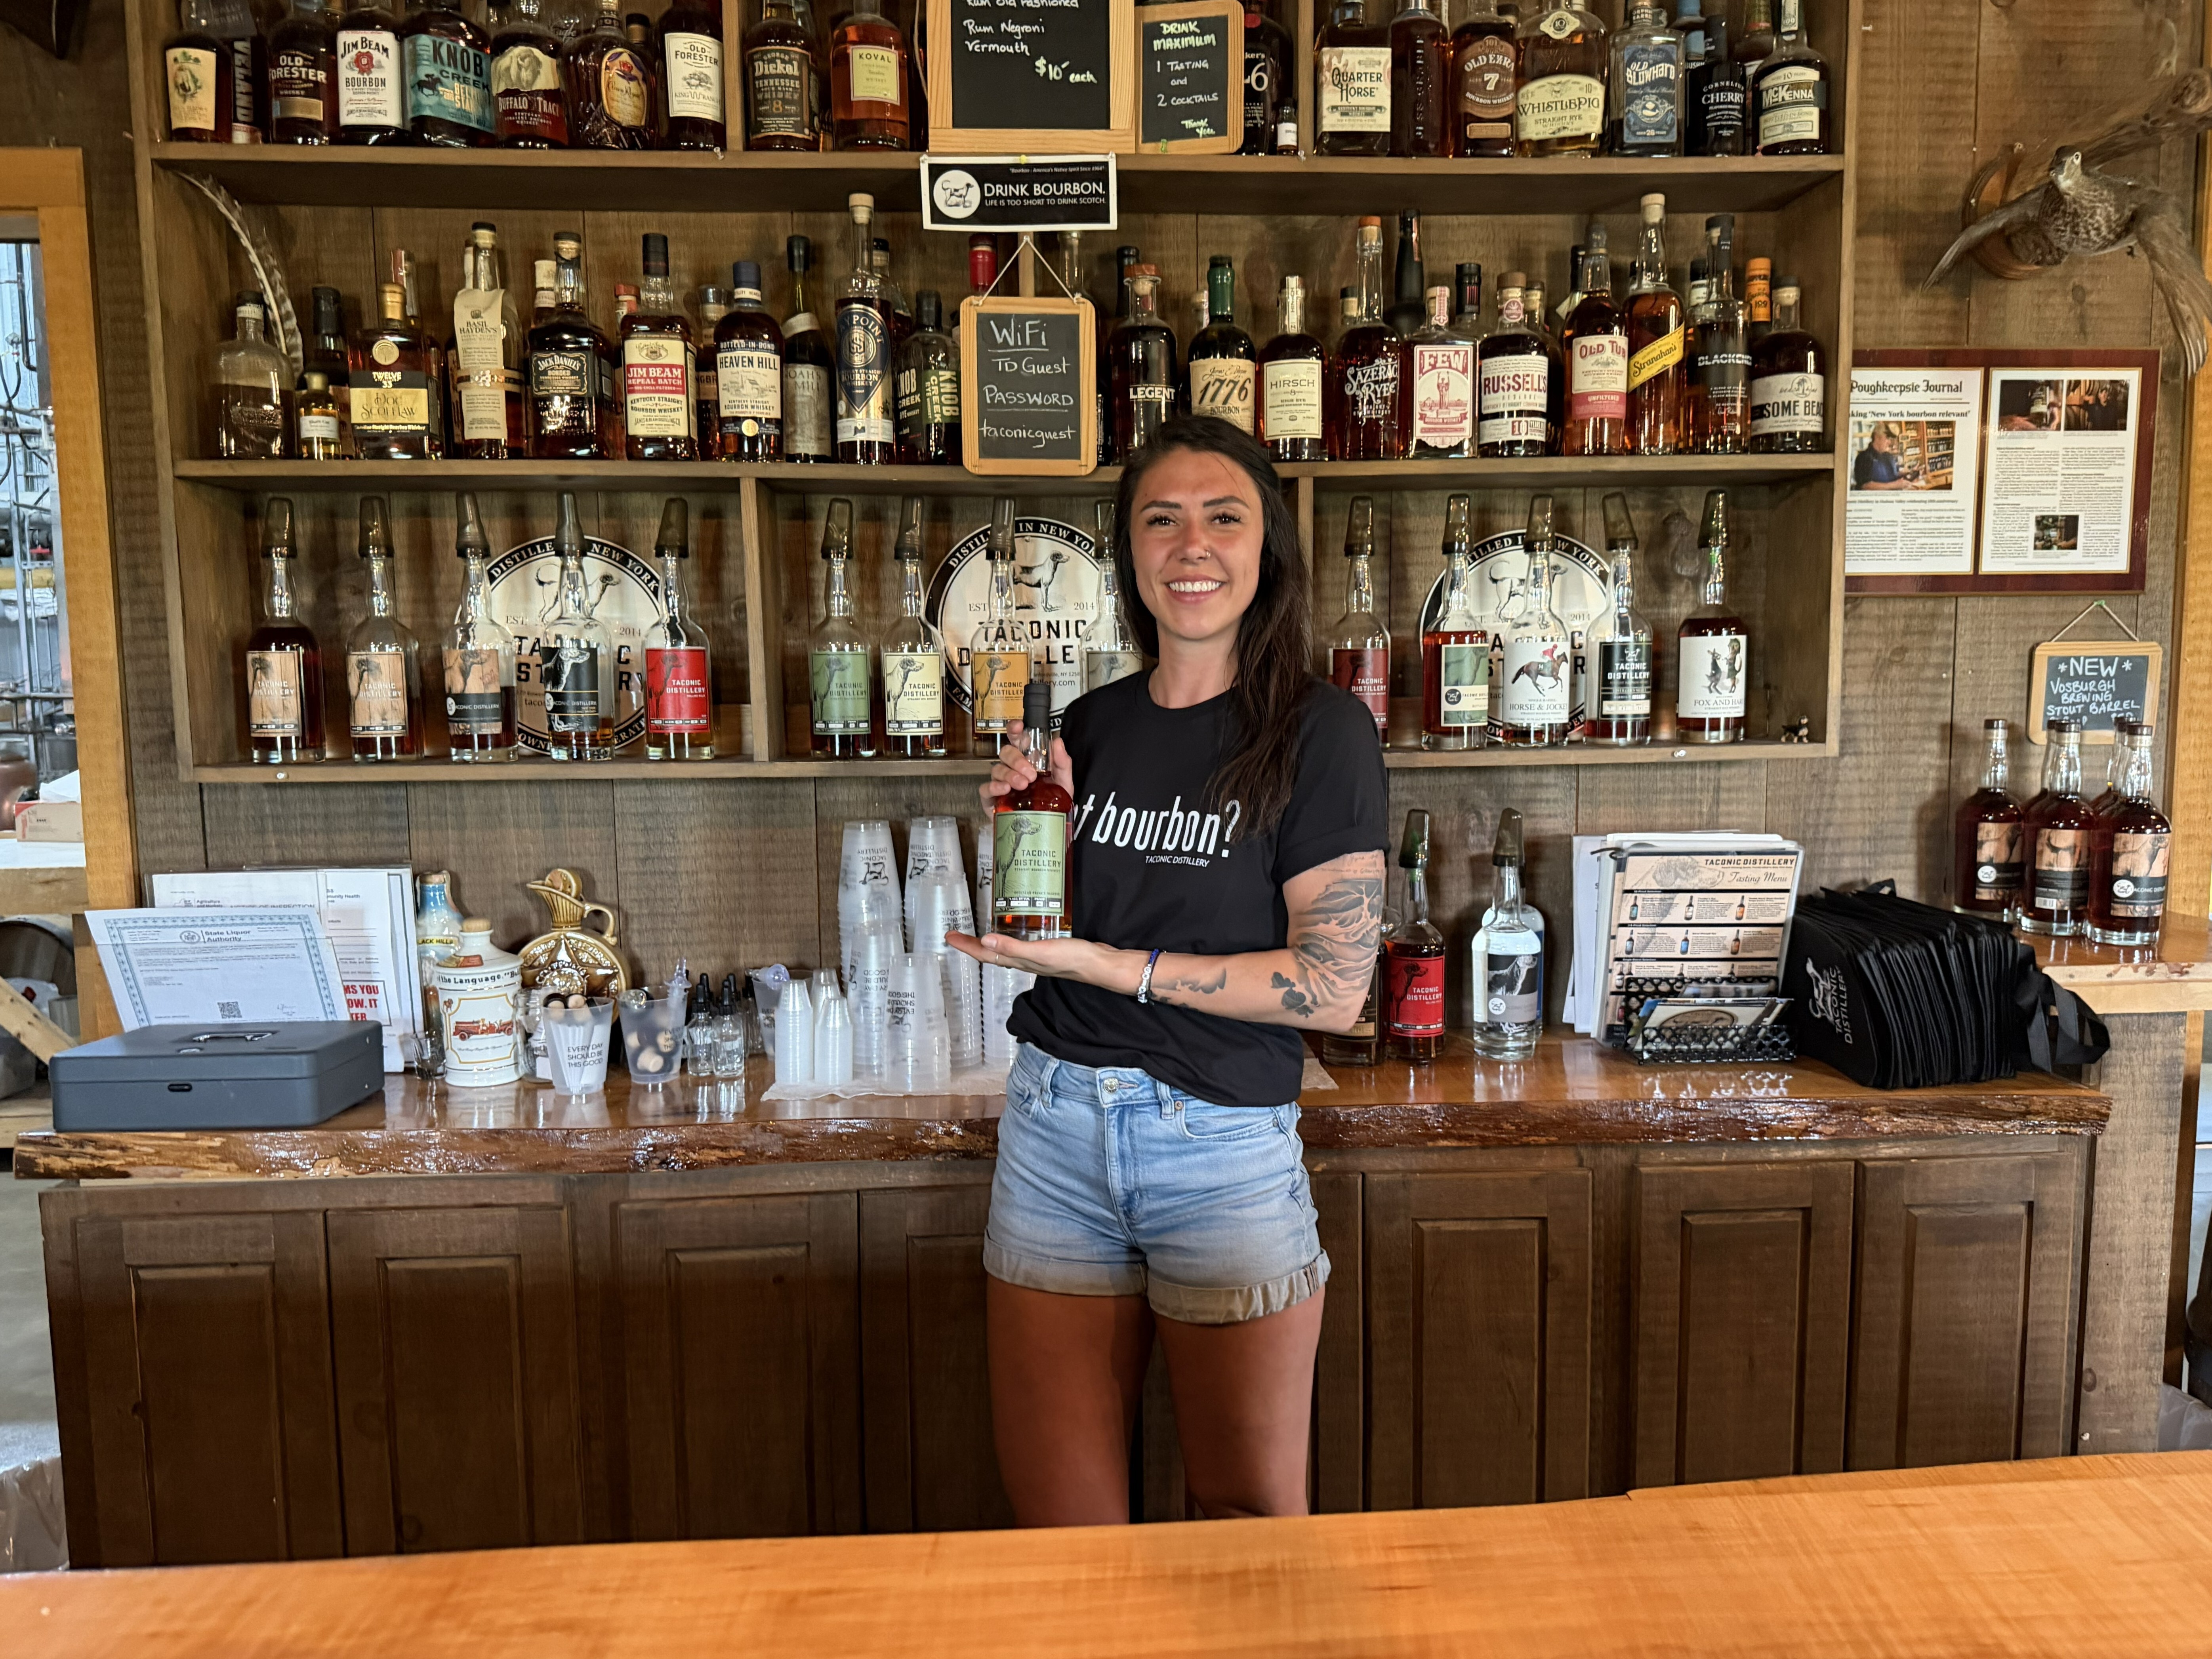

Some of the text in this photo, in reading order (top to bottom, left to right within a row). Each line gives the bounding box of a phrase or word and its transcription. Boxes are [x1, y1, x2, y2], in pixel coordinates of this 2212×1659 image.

[963, 18, 1045, 40] Rum Negroni
[1160, 21, 1200, 35] DRINK
[341, 36, 390, 60] JIM BEAM
[689, 44, 707, 53] OLD
[965, 40, 1030, 56] Vermouth
[1153, 34, 1216, 51] MAXIMUM
[279, 55, 304, 66] OLD
[431, 39, 484, 78] KNOB
[675, 51, 719, 66] FORESTER
[858, 53, 891, 63] KOVAL
[1464, 54, 1487, 72] OLD
[754, 59, 799, 76] Dickel
[1630, 61, 1649, 72] OLD
[345, 76, 387, 88] BOURBON
[439, 69, 491, 93] CREEK
[755, 79, 800, 89] TENNESSEE
[1069, 71, 1097, 84] each
[1171, 76, 1188, 86] and
[1331, 67, 1382, 86] QUARTER
[1483, 73, 1500, 91] 7
[1157, 92, 1219, 107] 2 COCKTAILS
[1340, 83, 1377, 104] HORSE
[1701, 92, 1745, 105] CHERRY
[498, 96, 529, 113] BUFFALO
[984, 181, 1106, 196] DRINK BOURBON.
[990, 314, 1047, 346] WiFi
[1579, 343, 1605, 360] OLD
[537, 357, 554, 371] JACK
[719, 355, 778, 370] HEAVEN HILL
[1022, 356, 1071, 375] Guest
[1422, 351, 1466, 372] FEW
[1632, 342, 1677, 378] Stranahan's
[372, 372, 402, 380] TWELVE
[627, 368, 682, 378] JIM BEAM
[1344, 364, 1398, 396] SAZERAC
[1198, 378, 1251, 405] 1776
[1270, 379, 1315, 389] HIRSCH
[1483, 372, 1547, 396] RUSSELL'S
[1922, 379, 1963, 393] Journal
[630, 396, 683, 405] KENTUCKY STRAIGHT
[930, 376, 942, 423] CREEK
[939, 370, 959, 416] KNOB
[983, 384, 1074, 406] PASSWORD
[1129, 387, 1175, 400] LEGENT
[898, 392, 921, 410] CREEK
[1210, 406, 1240, 415] BOURBON
[1763, 400, 1800, 418] SOME
[979, 417, 1076, 448] taconicguest
[1513, 420, 1528, 435] 10
[1019, 522, 1070, 538] IN NEW
[591, 543, 659, 591] NEW YORK
[1573, 543, 1604, 576] YORK
[1074, 602, 1095, 611] 2014
[1570, 613, 1590, 622] 2014
[2070, 656, 2119, 677] NEW
[2050, 677, 2116, 694] VOSBURGH
[1693, 698, 1710, 707] FOX
[2061, 691, 2112, 704] BREWING
[1510, 703, 1537, 711] HORSE
[2046, 700, 2140, 716] STOUT BARREL
[1092, 791, 1241, 858] bourbon?
[1022, 849, 1056, 858] TACONIC
[1014, 859, 1062, 868] DISTILLERY
[1145, 855, 1210, 868] TACONIC DISTILLERY
[1728, 871, 1787, 884] Tasting Menu
[358, 984, 379, 995] YOU
[368, 998, 378, 1008] IT
[1829, 965, 1843, 1034] TACONIC
[568, 1051, 597, 1060] SHOULD
[583, 1057, 603, 1067] GOOD
